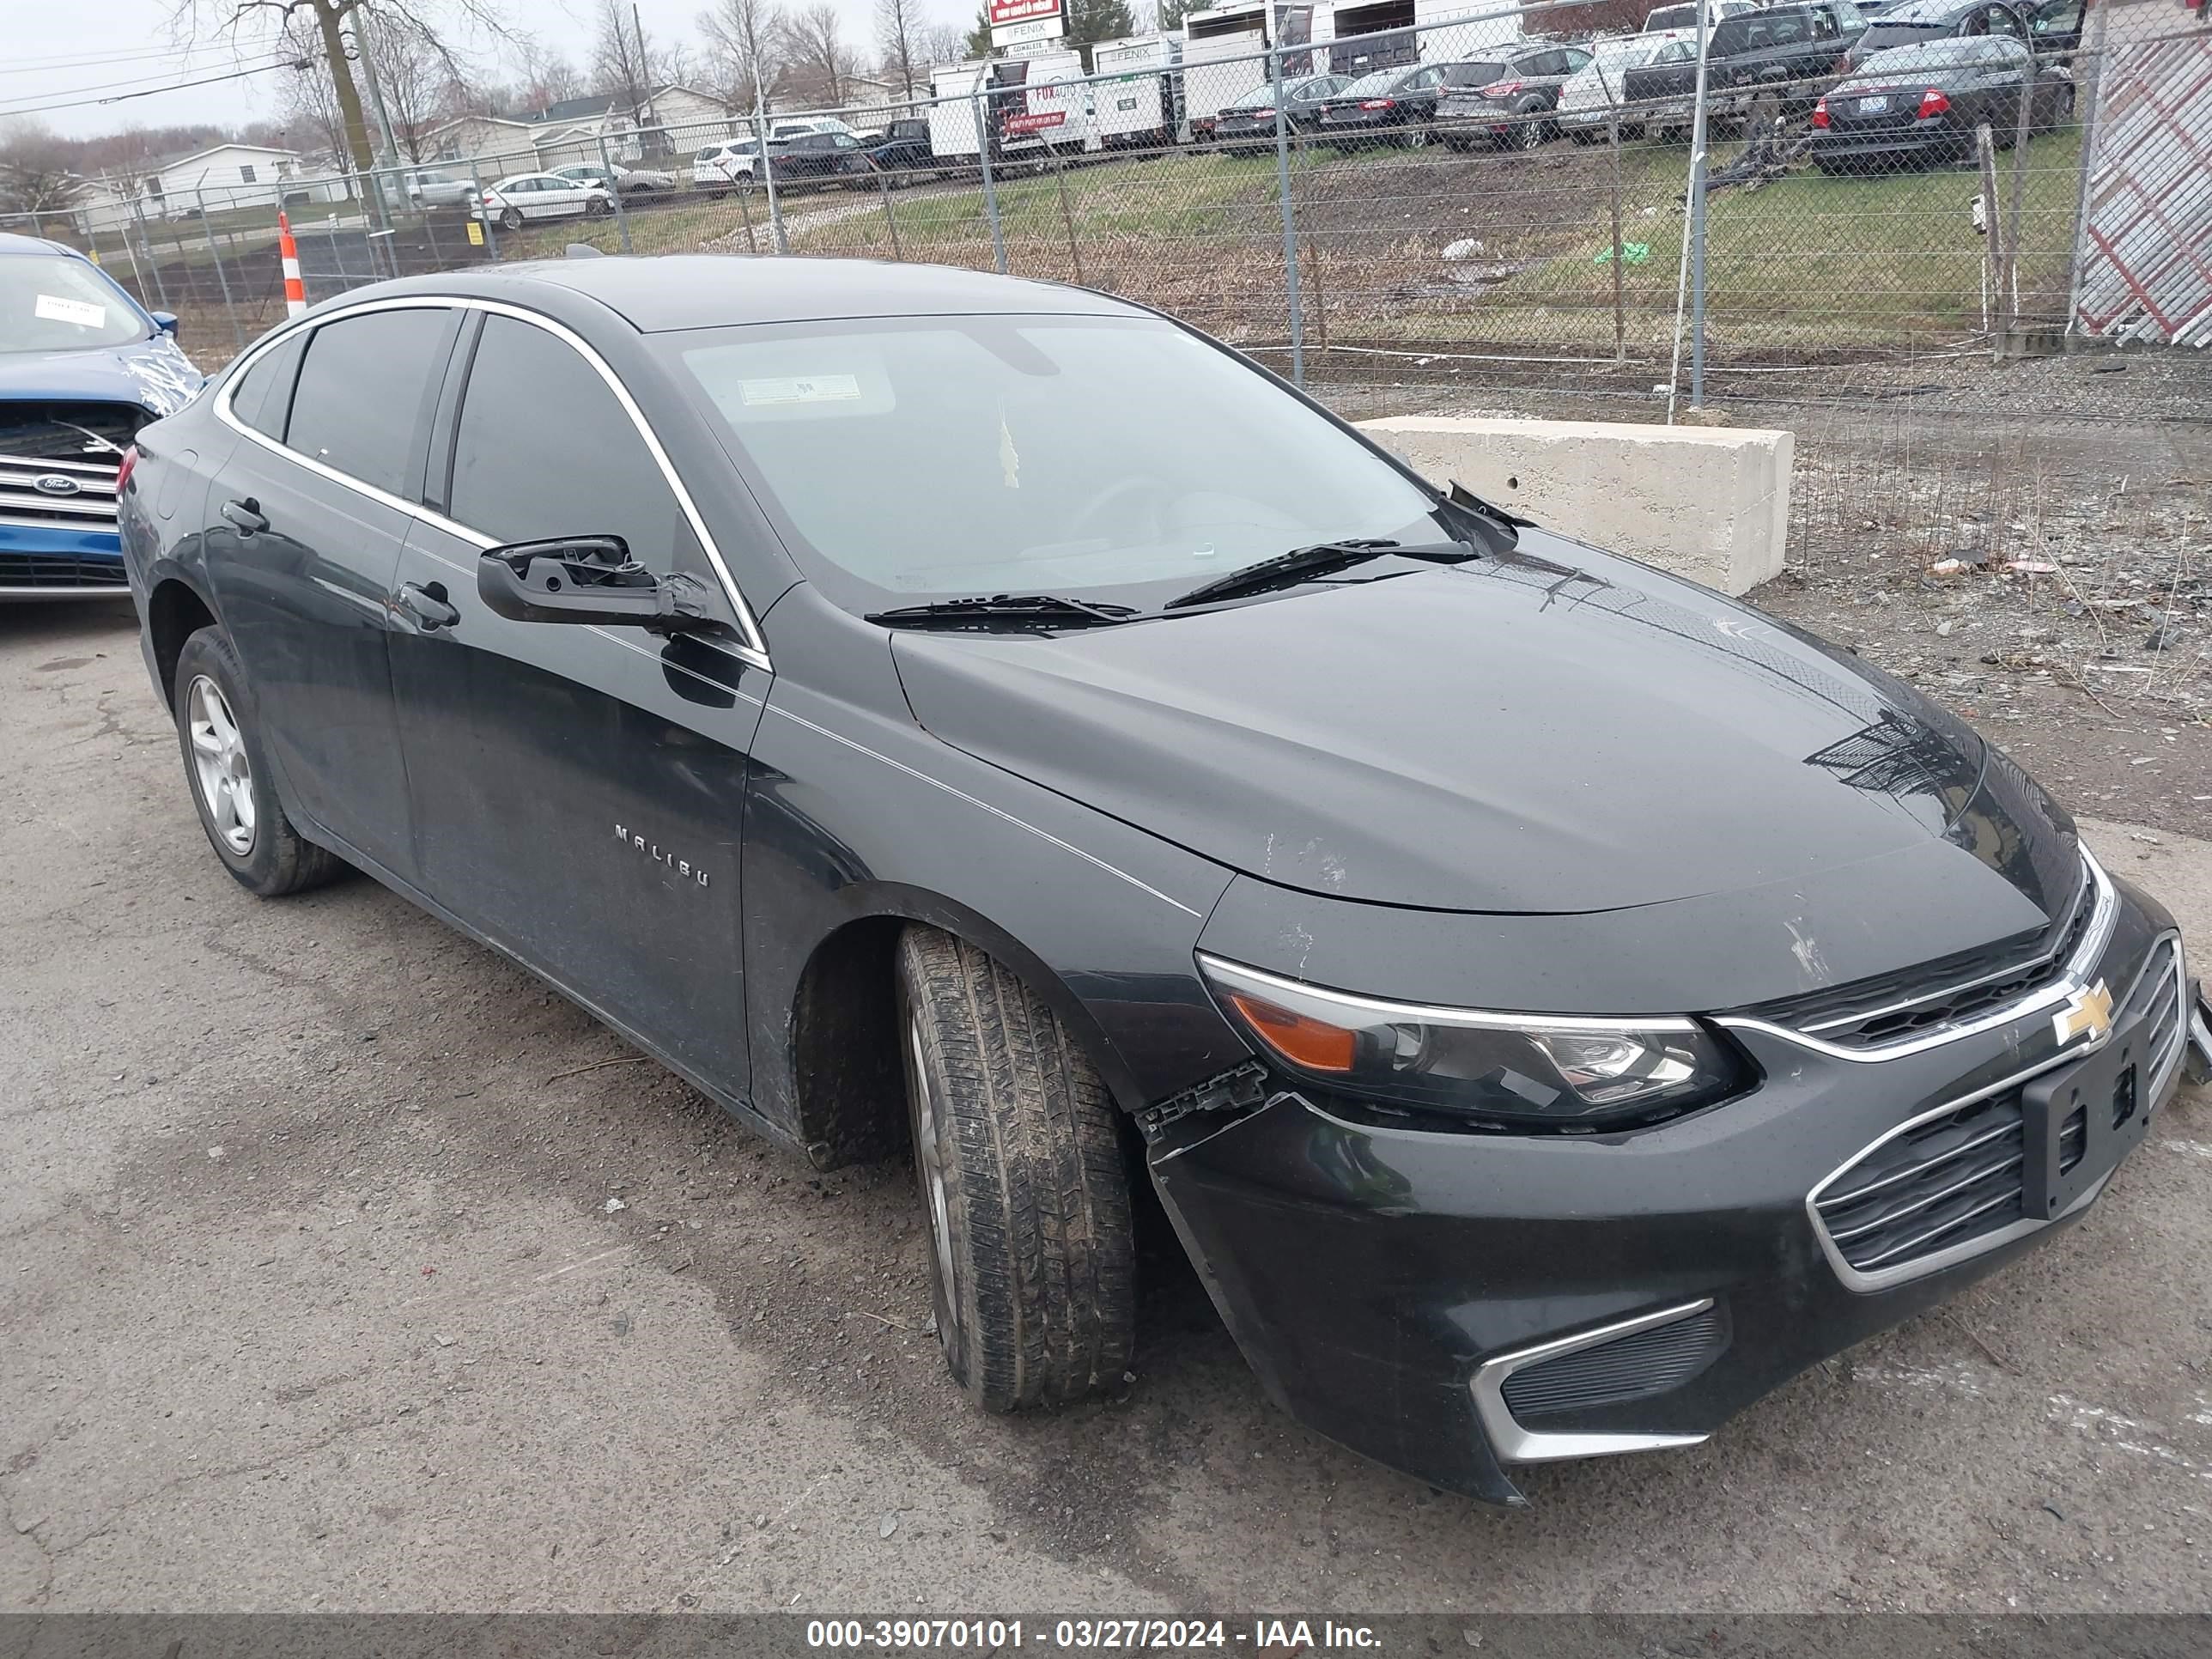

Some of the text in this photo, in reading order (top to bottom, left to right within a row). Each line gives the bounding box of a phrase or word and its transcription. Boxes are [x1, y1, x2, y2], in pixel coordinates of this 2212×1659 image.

[1013, 22, 1045, 36] FENIX
[1117, 48, 1151, 60] FENIX
[615, 823, 709, 887] MALIBU
